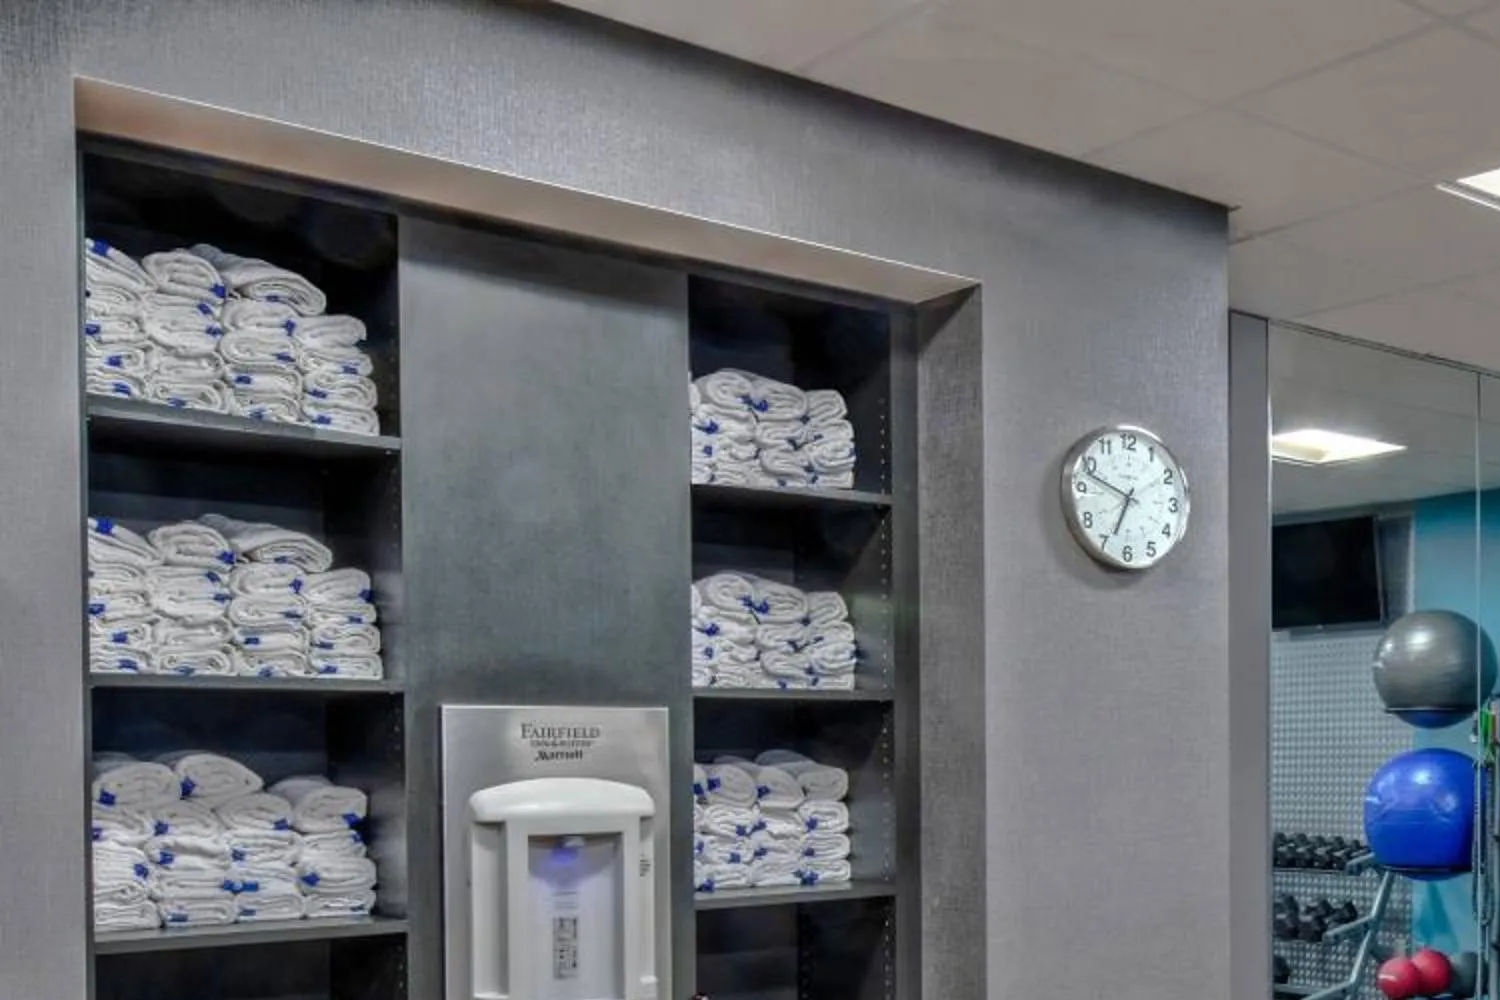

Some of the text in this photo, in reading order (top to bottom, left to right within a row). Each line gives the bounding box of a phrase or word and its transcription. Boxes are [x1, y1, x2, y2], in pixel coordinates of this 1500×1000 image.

[1098, 438, 1111, 455] 11
[1120, 433, 1136, 451] 12
[1147, 446, 1154, 462] 1
[1082, 456, 1097, 476] 10
[1163, 467, 1173, 485] 2
[1168, 496, 1179, 513] 3
[1083, 511, 1093, 528] 8
[1161, 523, 1171, 538] 4
[1099, 534, 1109, 551] 7
[1146, 541, 1157, 557] 5
[1122, 545, 1133, 562] 6
